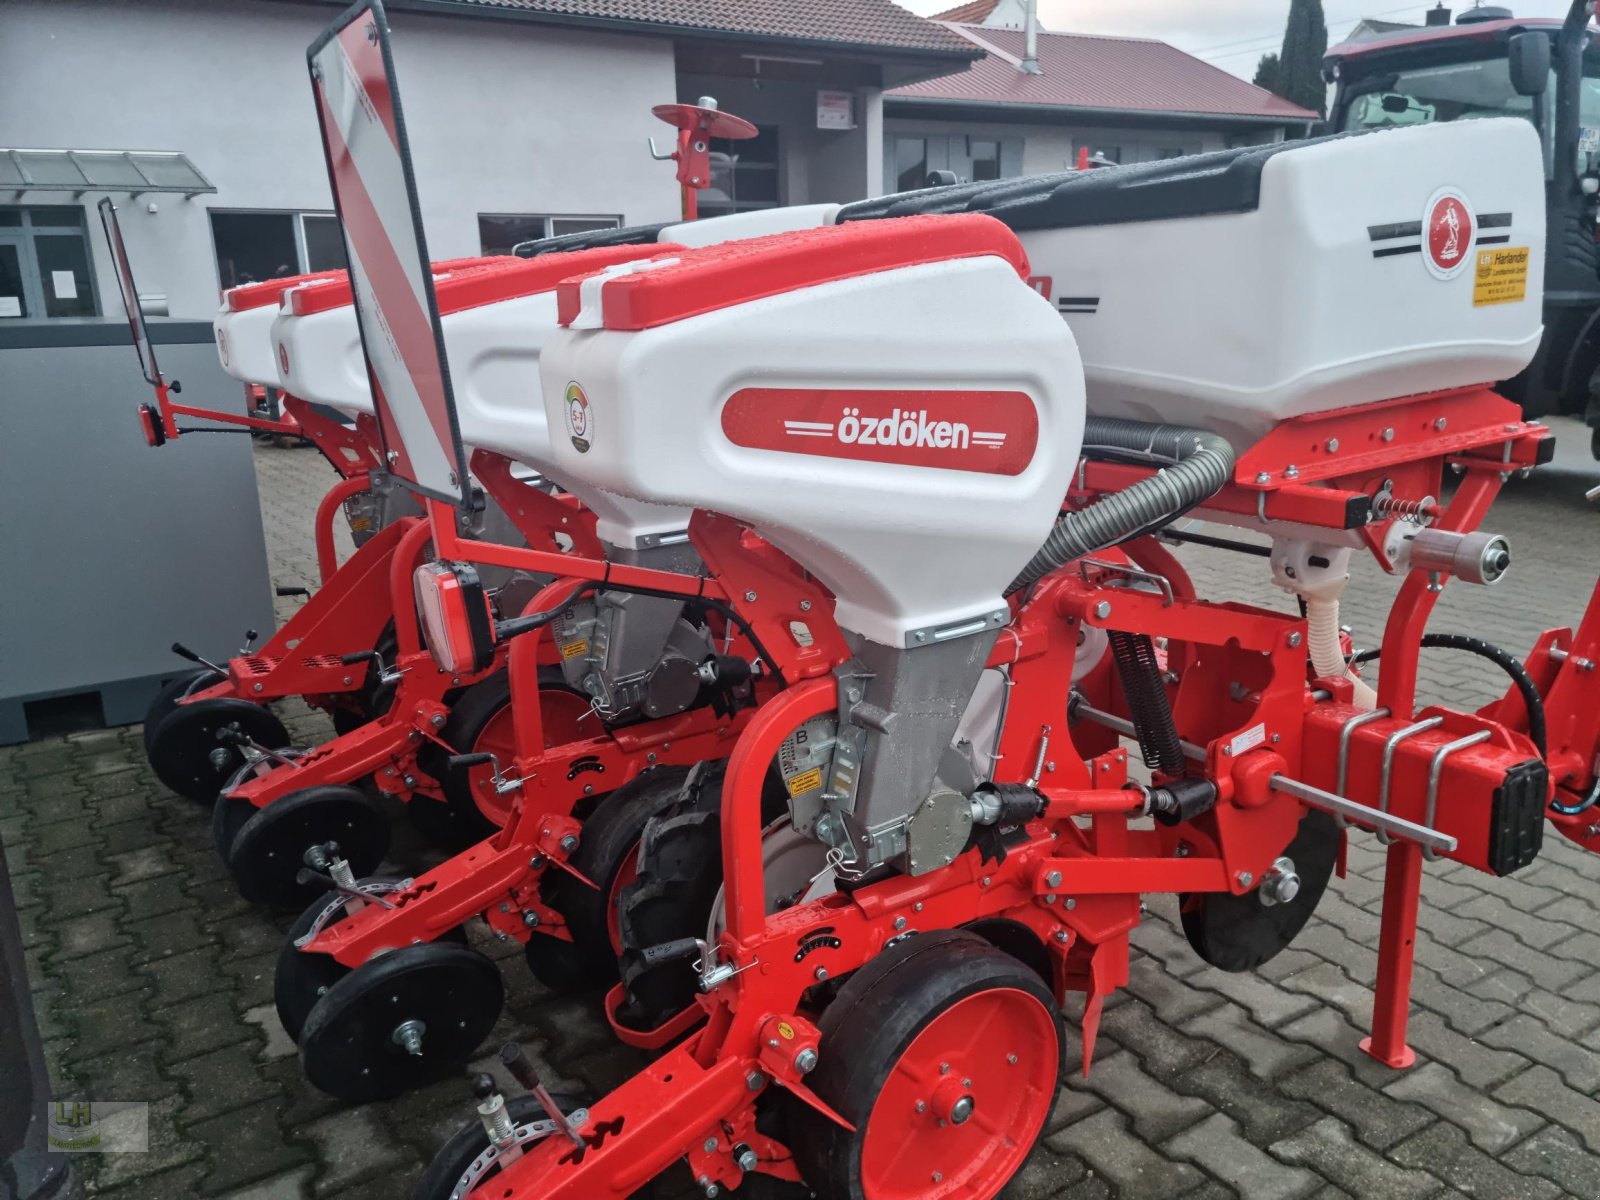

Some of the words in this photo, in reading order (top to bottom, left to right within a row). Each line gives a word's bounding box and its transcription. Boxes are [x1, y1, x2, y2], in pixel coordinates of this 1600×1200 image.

[1495, 252, 1527, 265] Harlander
[838, 407, 970, 449] özdöken
[565, 608, 575, 620] B
[796, 730, 808, 744] B
